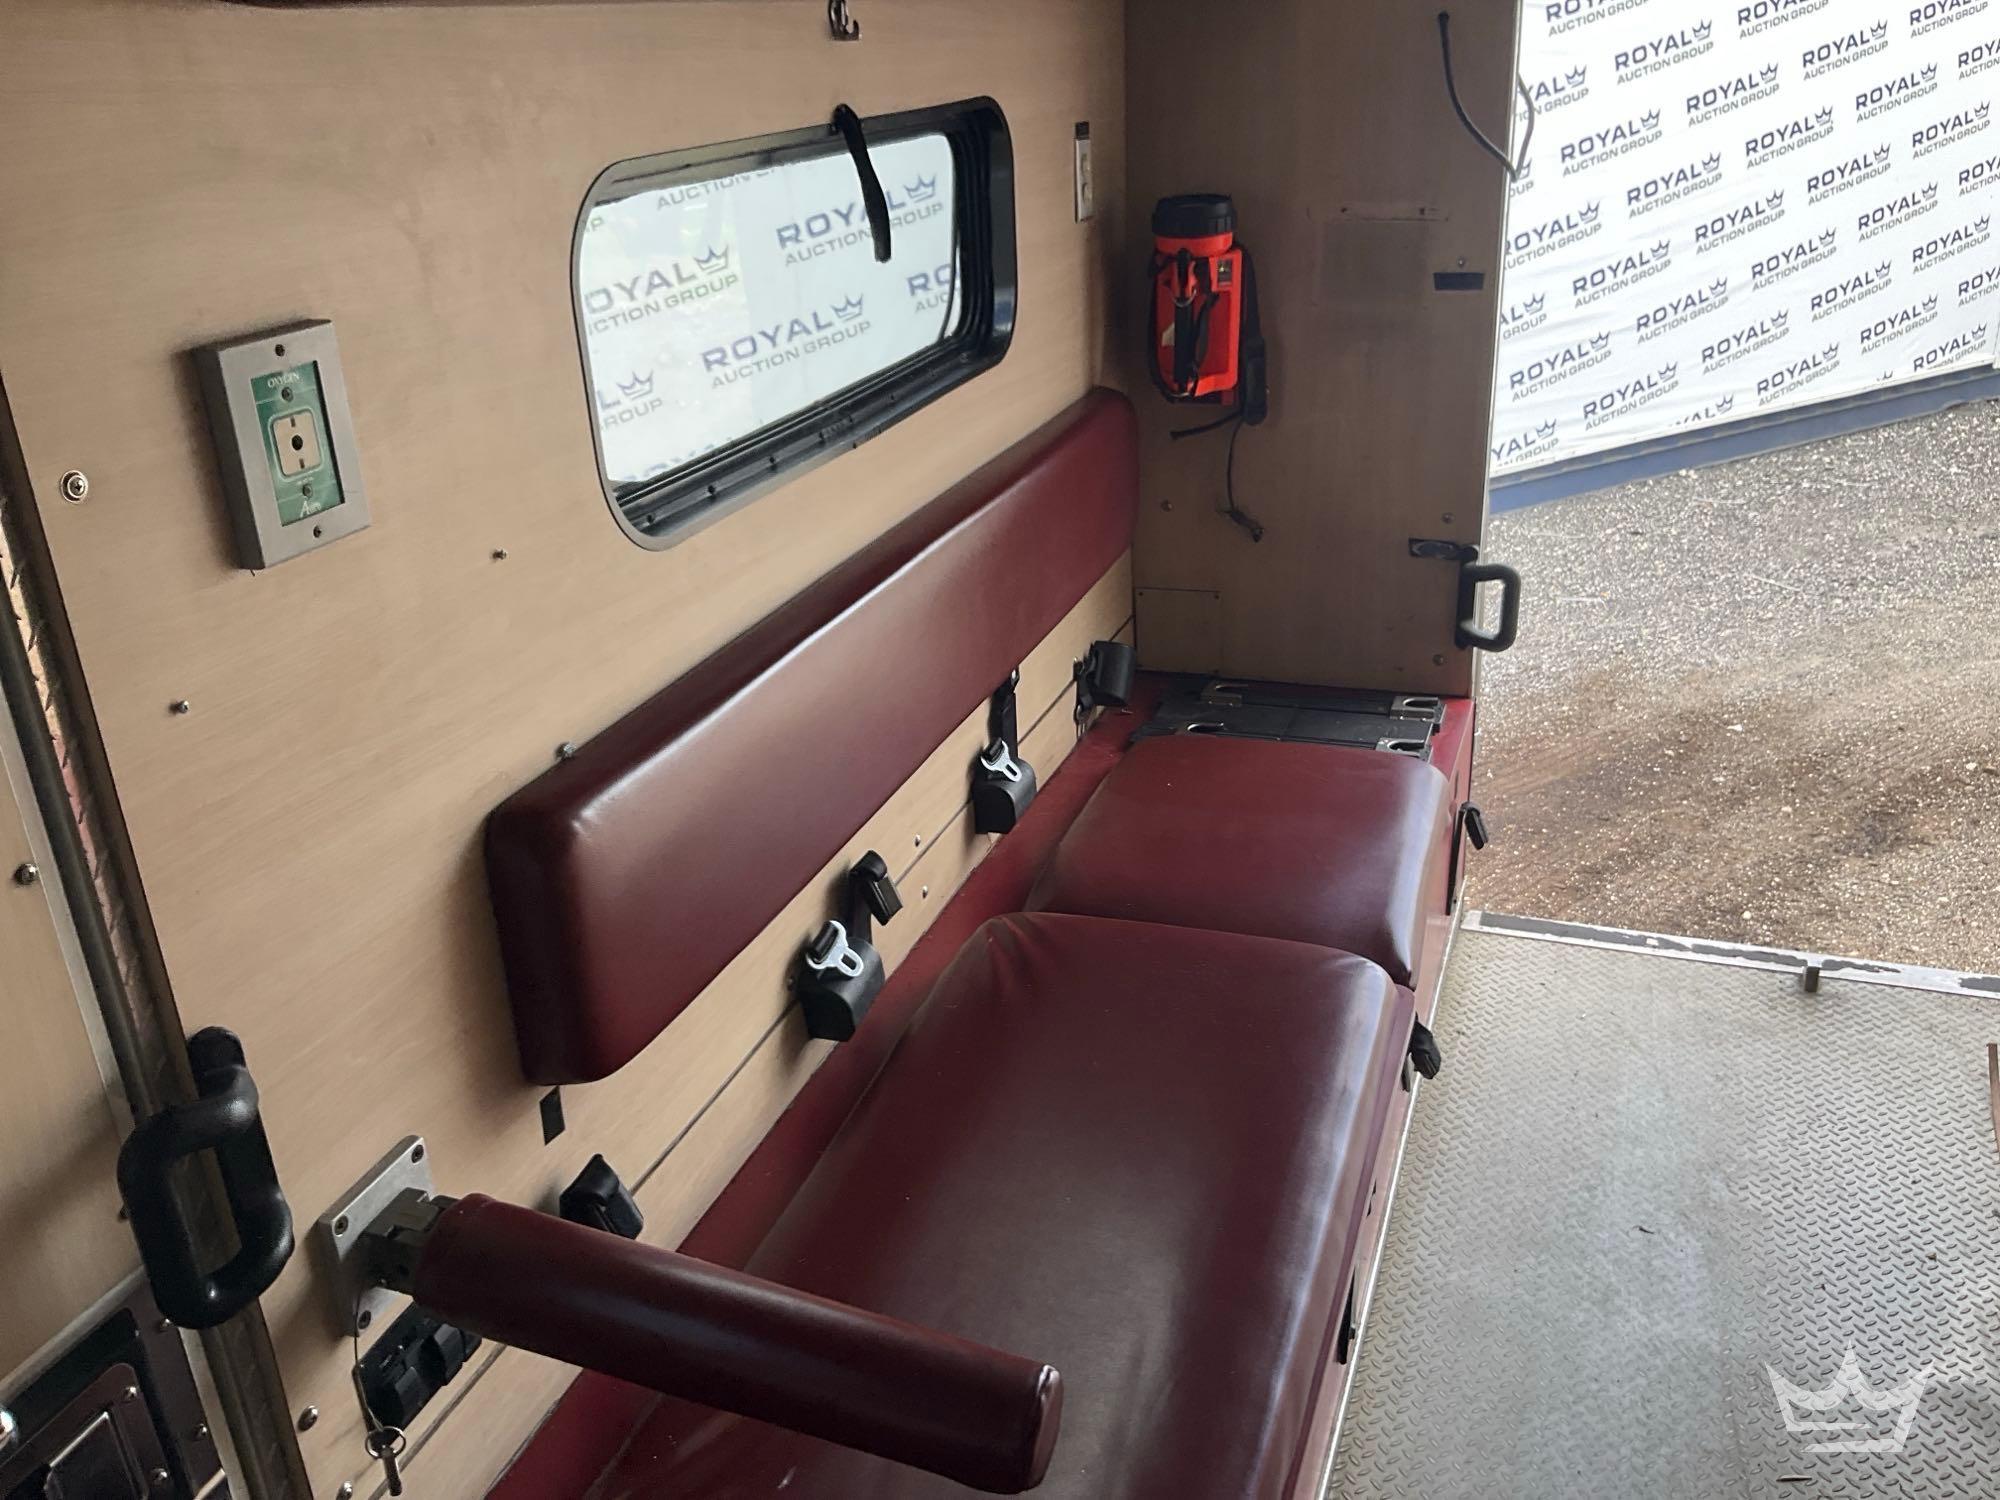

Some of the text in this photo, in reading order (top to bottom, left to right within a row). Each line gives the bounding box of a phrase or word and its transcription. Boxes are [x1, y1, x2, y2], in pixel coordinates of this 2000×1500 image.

[1549, 7, 1605, 37] AUCTION
[1740, 0, 1829, 40] AUCTION GROUP
[1910, 1, 1989, 39] AUCTION GROUP
[1615, 30, 1693, 72] ROYAL
[1617, 41, 1714, 85] AUCTION GROUP
[1802, 31, 1870, 68] ROYAL
[1803, 41, 1888, 81] AUCTION GROUP
[1544, 88, 1589, 112] GROUP
[1686, 73, 1760, 114] ROYAL
[1688, 84, 1780, 128] AUCTION GROUP
[1856, 72, 1920, 111] ROYAL
[1857, 83, 1938, 123] AUCTION GROUP
[1561, 120, 1641, 164] ROYAL
[1745, 117, 1815, 157] ROYAL
[1747, 126, 1833, 169] AUCTION GROUP
[1912, 111, 1974, 148] ROYAL
[1912, 120, 1990, 160] AUCTION GROUP
[1563, 131, 1663, 177] AUCTION GROUP
[1807, 154, 1873, 193] ROYAL
[1627, 164, 1702, 206] ROYAL
[1629, 173, 1722, 219] AUCTION GROUP
[1808, 163, 1891, 206] AUCTION GROUP
[776, 191, 907, 250] ROYL
[891, 202, 944, 229] ROUP
[1696, 201, 1766, 243] ROYAL
[1696, 209, 1785, 255] AUCTION GROUP
[1858, 192, 1921, 231] ROYAL
[1859, 200, 1938, 242] AUCTION GROUP
[1504, 222, 1602, 271] UCTION GROUP
[1752, 238, 1818, 280] ROYAL
[1912, 226, 1974, 263] ROYAL
[1913, 233, 1990, 274] AUCTION GROUP
[584, 262, 697, 315] OYAL
[1572, 250, 1651, 296] ROYAL
[1574, 260, 1671, 309] AUCTION GROUP
[1753, 246, 1837, 291] AUCTION GROUP
[664, 274, 739, 309] GROUP
[1636, 287, 1710, 332] ROYAL
[1811, 271, 1874, 311] ROYAL
[1812, 278, 1892, 322] AUCTION GROUP
[1958, 281, 1999, 307] AUCTION
[702, 309, 832, 372] ROYAL
[1503, 313, 1547, 340] GROUP
[1638, 296, 1729, 344] AUCTION GROUP
[1860, 304, 1922, 344] ROYAL
[1861, 312, 1938, 355] AUCTION GROUP
[713, 320, 871, 389] AUCTION GROUP
[1702, 320, 1770, 364] ROYAL
[1703, 327, 1790, 376] AUCTION GROUP
[1913, 333, 1971, 373] ROYAL
[1955, 340, 1986, 361] GROUP
[1510, 343, 1590, 390] ROYAL
[1512, 351, 1611, 402] AUCTION GROUP
[1757, 354, 1822, 395] ROYAL
[1758, 361, 1840, 406] AUCTION GROUP
[1583, 373, 1659, 419] ROYAL
[1585, 401, 1638, 431] AUCTION
[1640, 381, 1679, 405] GROUP
